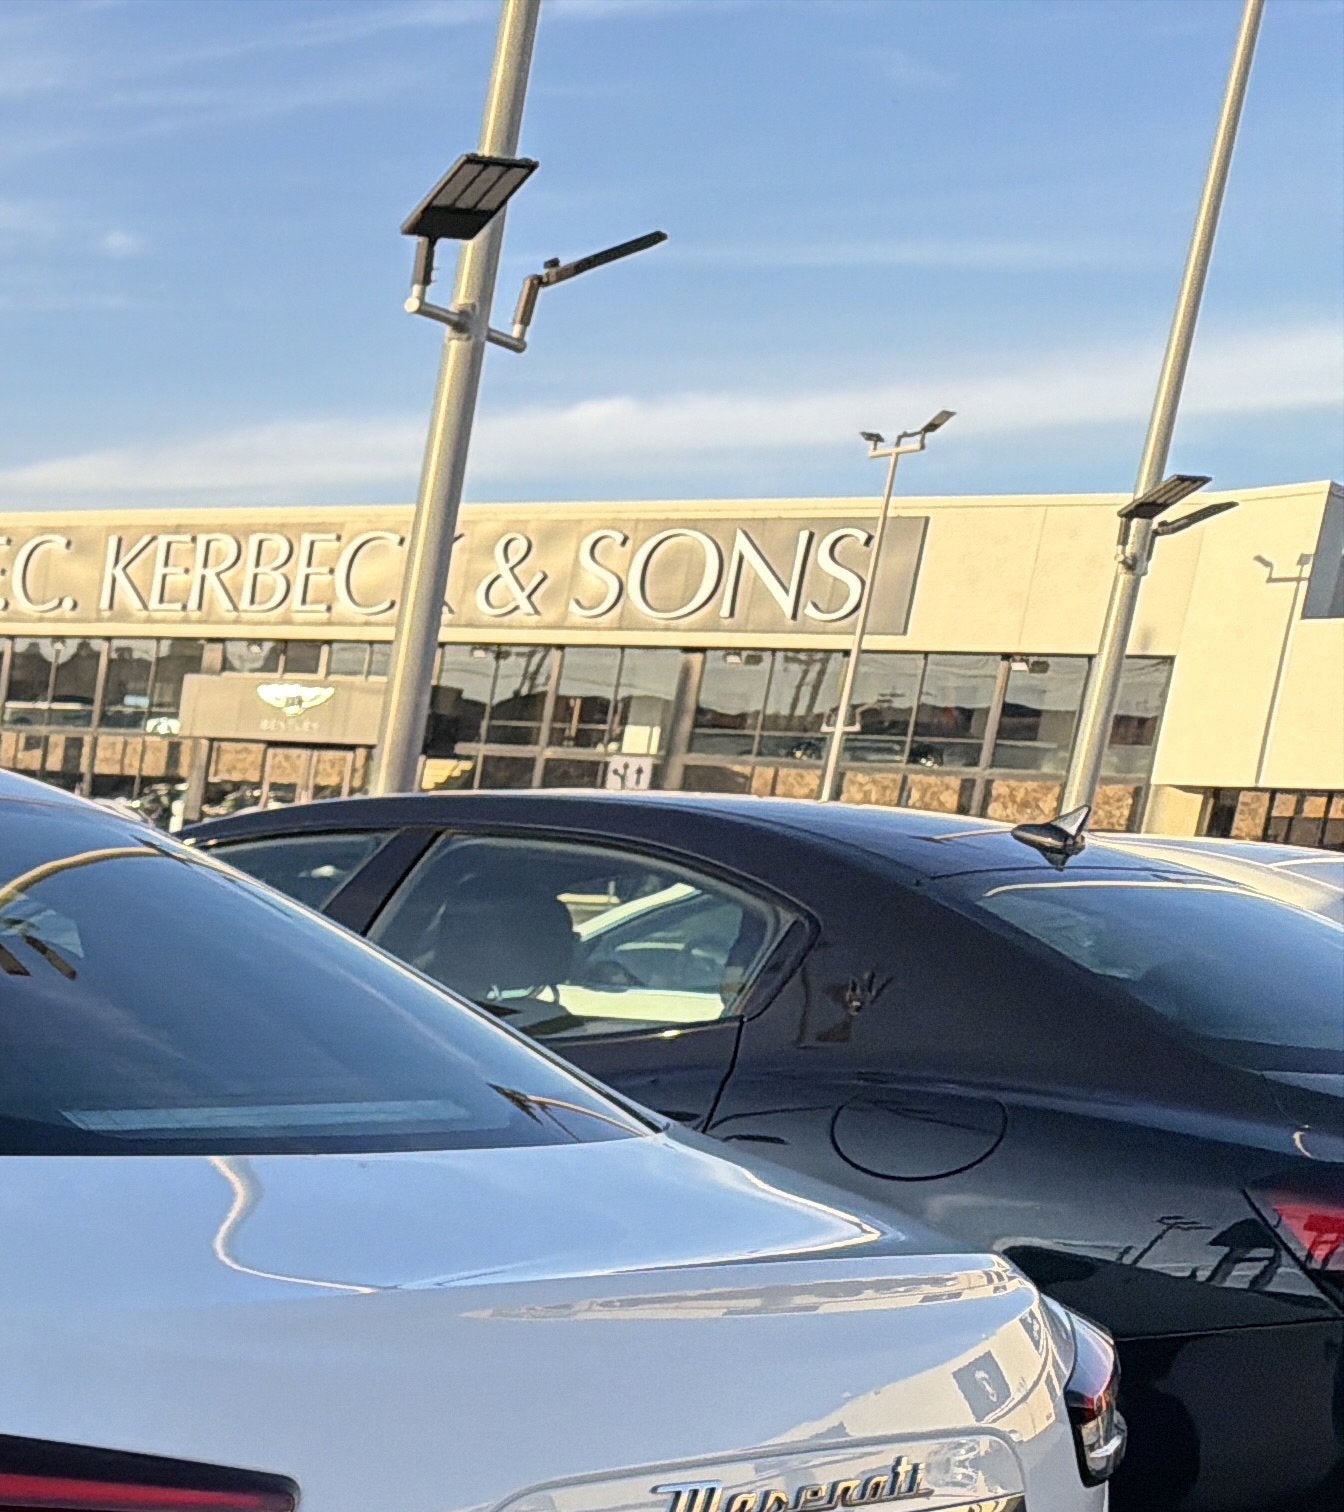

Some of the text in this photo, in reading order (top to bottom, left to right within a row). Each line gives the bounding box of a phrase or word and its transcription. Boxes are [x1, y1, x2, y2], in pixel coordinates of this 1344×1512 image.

[99, 531, 464, 615] KERBEC
[475, 531, 549, 618] &
[567, 527, 874, 624] SONS
